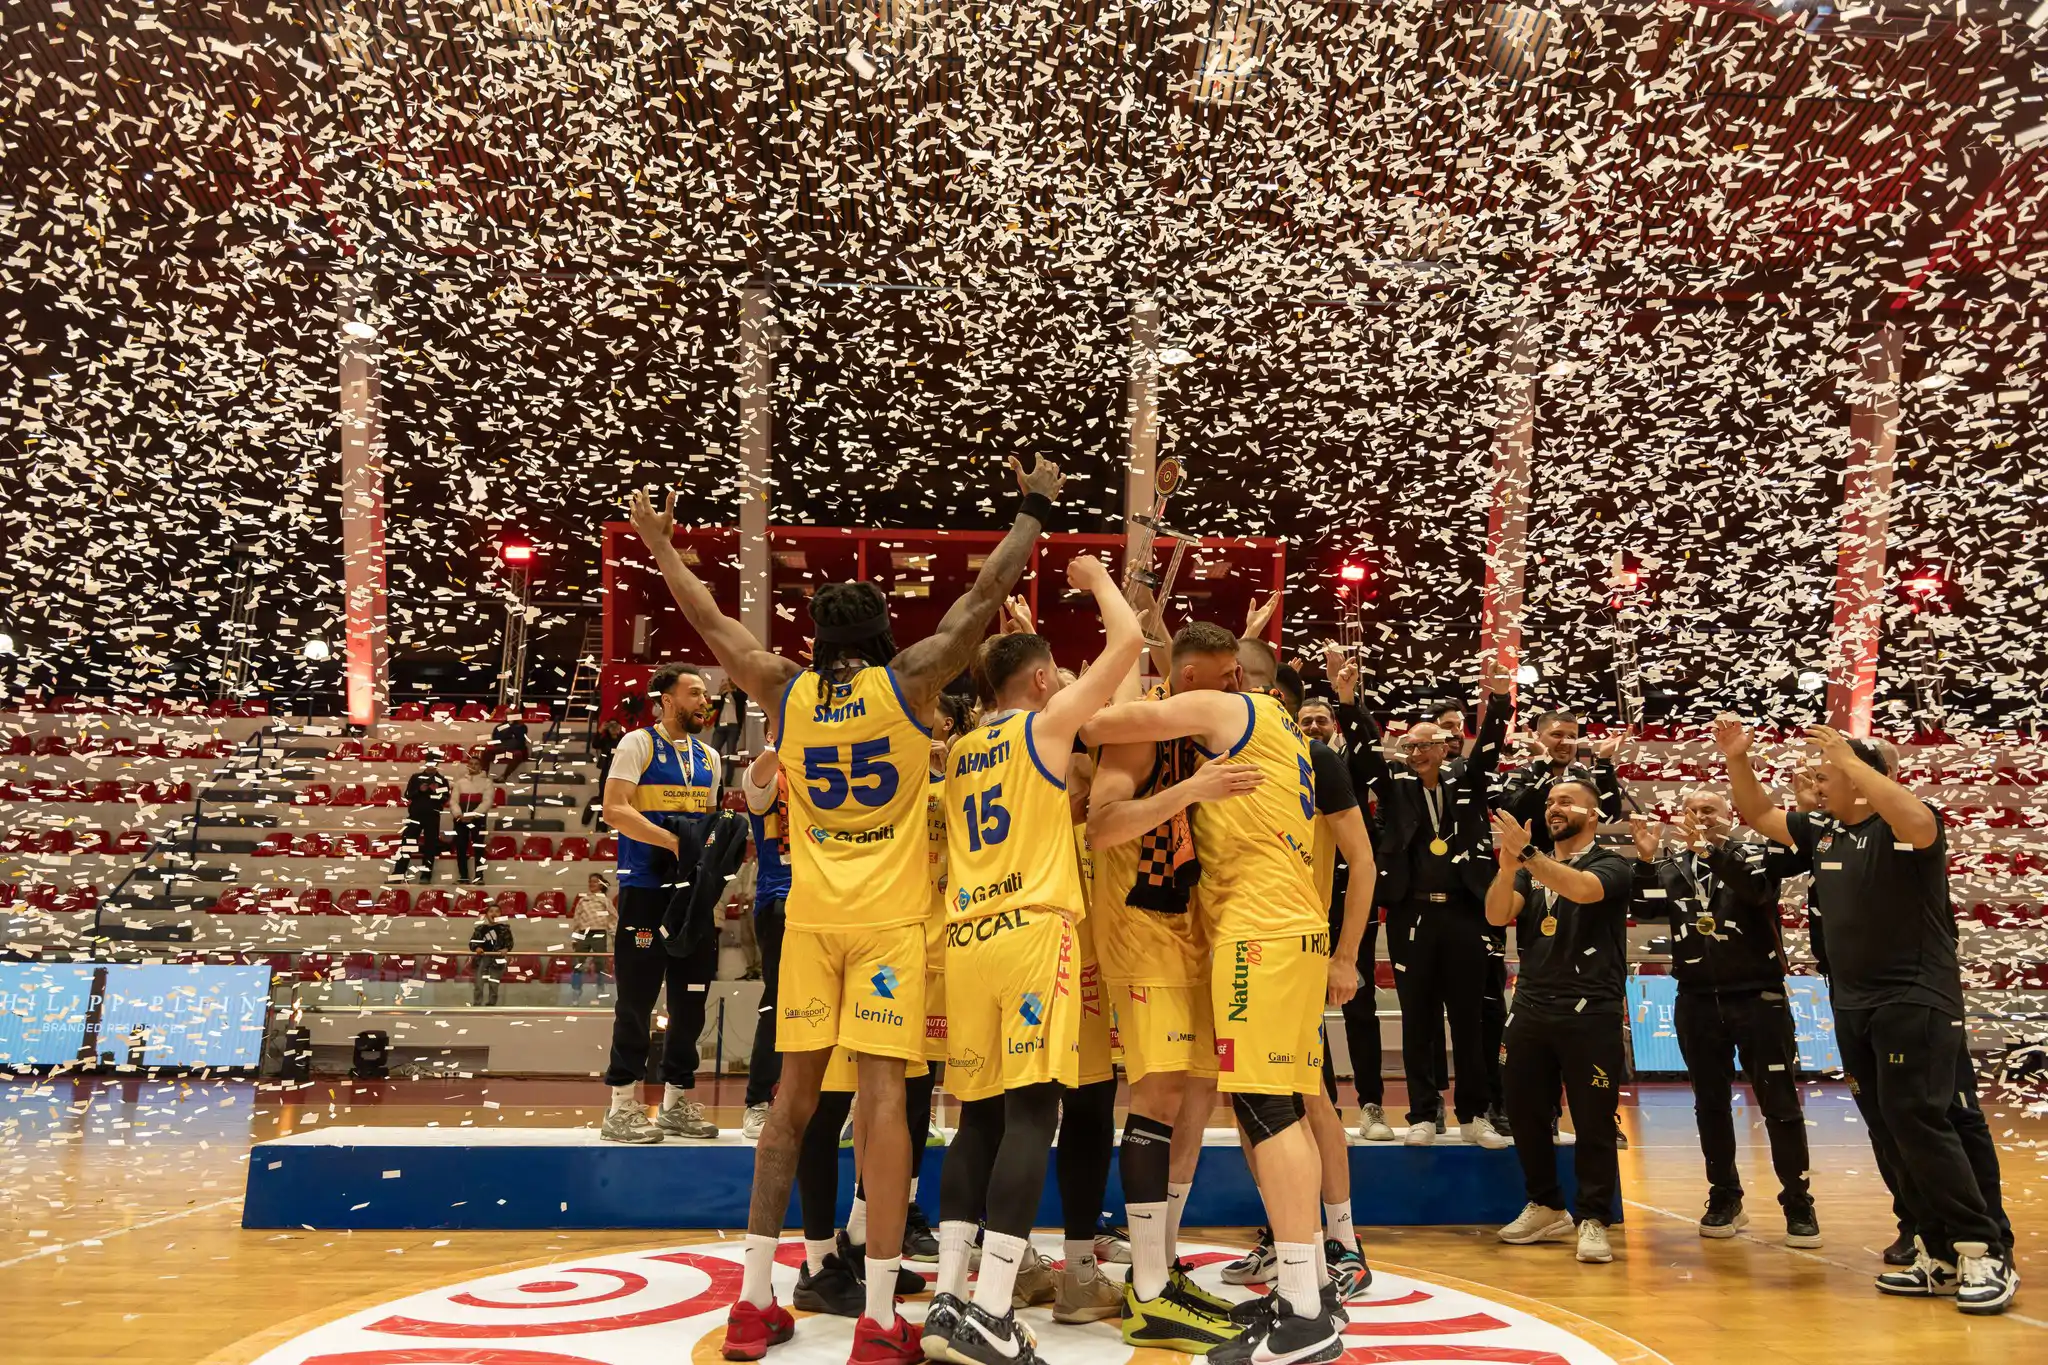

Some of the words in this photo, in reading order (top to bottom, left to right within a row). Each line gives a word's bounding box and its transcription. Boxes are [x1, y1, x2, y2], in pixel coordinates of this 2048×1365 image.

[813, 697, 866, 723] SMITH
[803, 736, 899, 810] 55
[963, 782, 1011, 852] 15
[834, 824, 895, 845] Graniti
[855, 1002, 904, 1027] Lenita
[42, 1023, 103, 1034] BRANDED
[1008, 1036, 1044, 1055] Lenia
